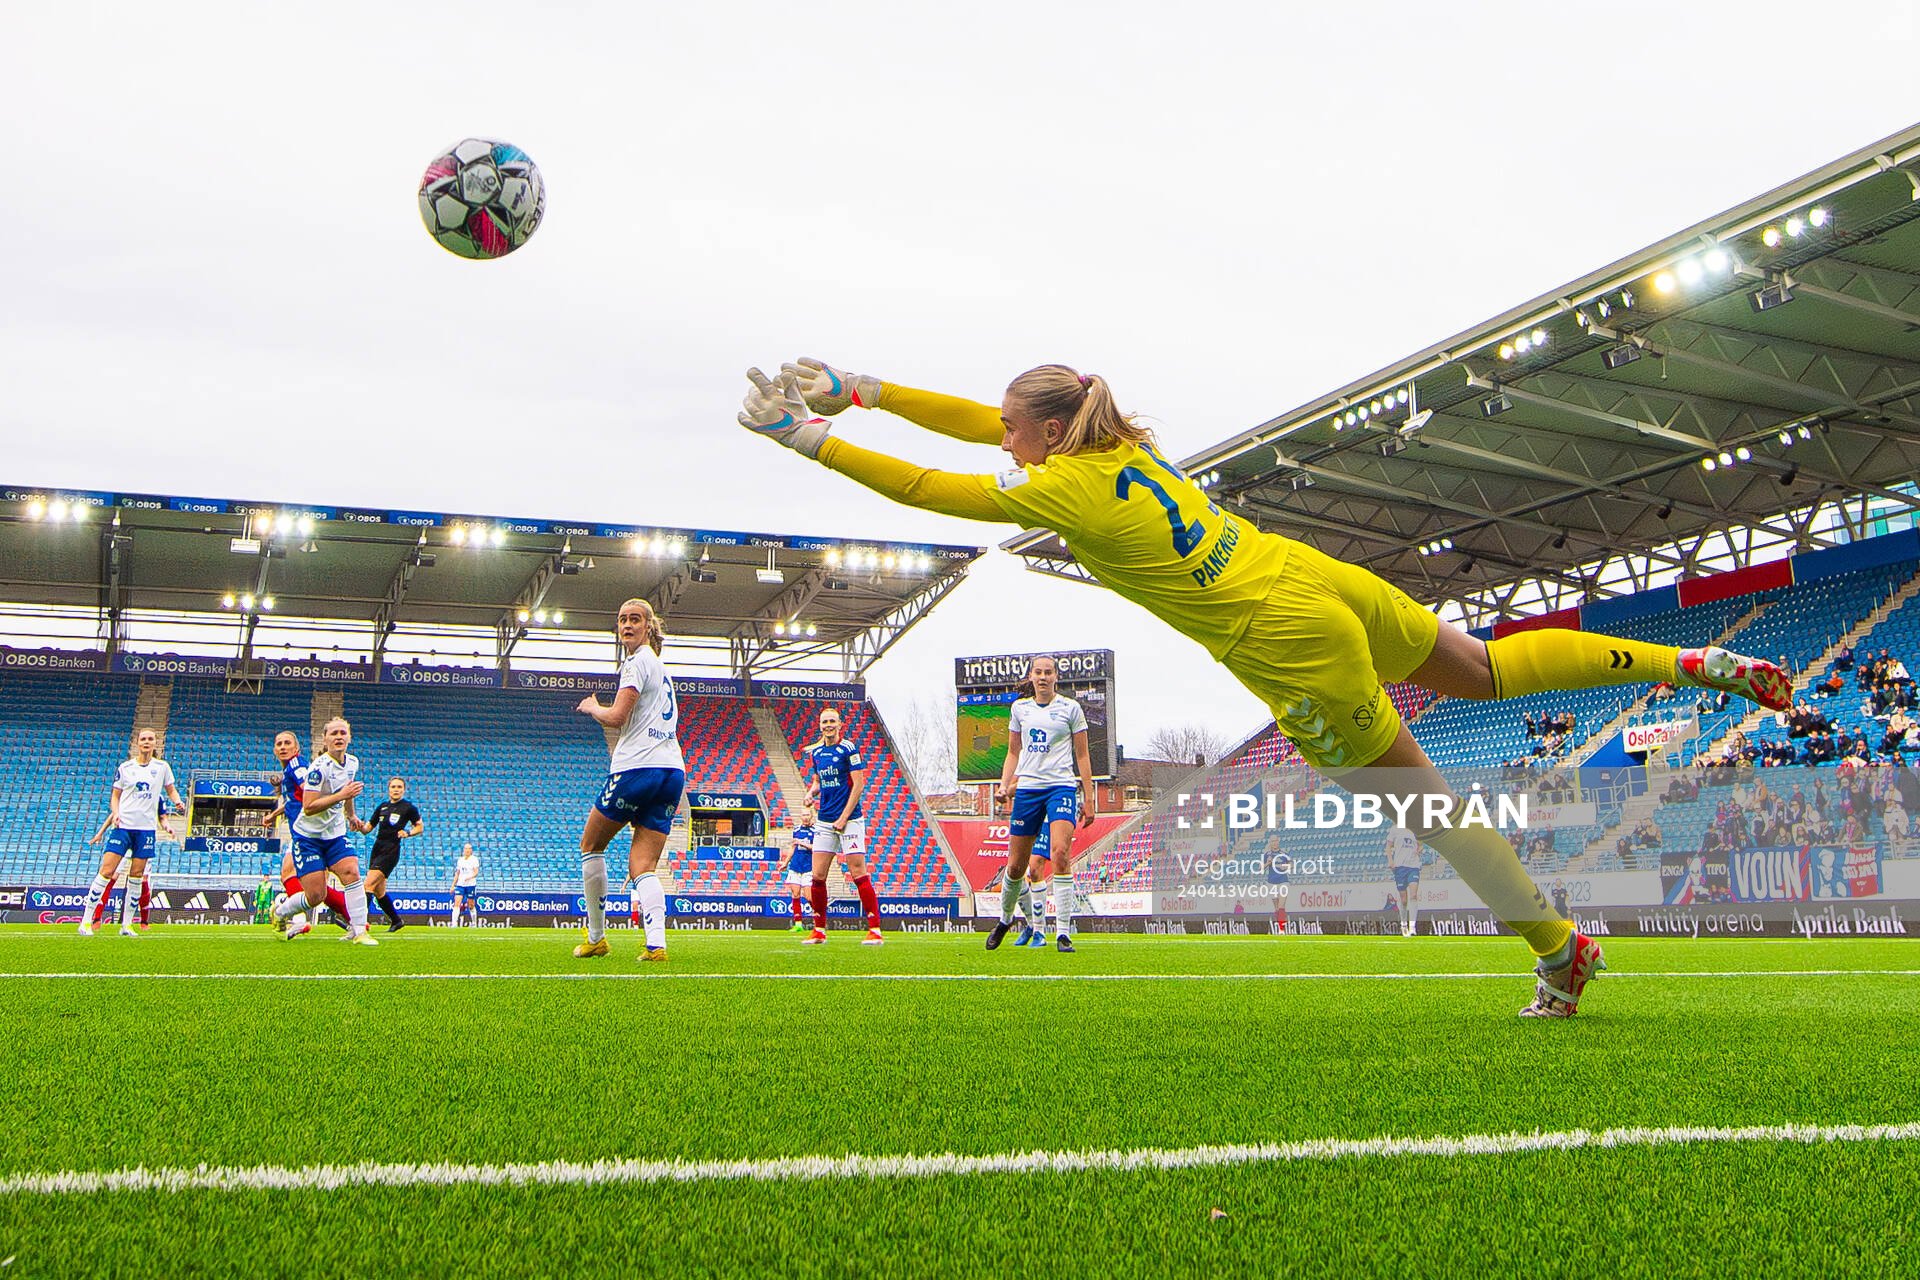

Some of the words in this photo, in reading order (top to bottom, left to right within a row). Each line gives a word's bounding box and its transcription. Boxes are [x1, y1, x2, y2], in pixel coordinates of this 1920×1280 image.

[136, 501, 161, 509] OBOS
[357, 515, 381, 523] OBOS
[762, 540, 784, 548] OBOS
[6, 653, 47, 666] OBOS
[49, 656, 96, 669] Banken
[964, 654, 1030, 679] intility
[1056, 655, 1096, 672] ena
[146, 660, 186, 673] OBOS
[188, 662, 226, 674] Banke
[282, 665, 320, 677] OBOS
[322, 667, 365, 680] Banken
[412, 671, 450, 683] OBOS
[452, 673, 493, 685] Banken
[539, 676, 575, 688] OBOS
[577, 678, 617, 690] Banken
[673, 682, 696, 692] BOS
[698, 683, 737, 694] Banken
[781, 686, 815, 697] OBOS
[817, 687, 854, 699] Banken
[1027, 744, 1051, 754] OBOS
[229, 786, 261, 796] OBOS
[713, 798, 742, 808] OBOS
[224, 841, 258, 852] OBOS
[735, 849, 765, 860] OBOS
[977, 849, 1009, 857] MATER
[392, 899, 427, 910] OBOS
[429, 899, 455, 910] Bank
[1300, 891, 1343, 908] OsloTaxi
[496, 900, 530, 910] OBOS
[531, 900, 569, 911] Banken
[606, 901, 629, 912] BOS
[693, 902, 725, 912] OBOS
[727, 902, 763, 913] Banken
[827, 905, 855, 914] anken
[880, 903, 911, 914] OBOS
[912, 904, 946, 915] Banken
[551, 917, 589, 928] April
[1299, 915, 1323, 934] Bank
[1429, 913, 1465, 936] Aprila
[1467, 914, 1499, 936] Bank
[1573, 911, 1610, 935] Bank
[1637, 908, 1699, 939] intility
[1706, 911, 1764, 933] arena
[1790, 905, 1851, 939] Aprila
[1855, 905, 1906, 934] Bank
